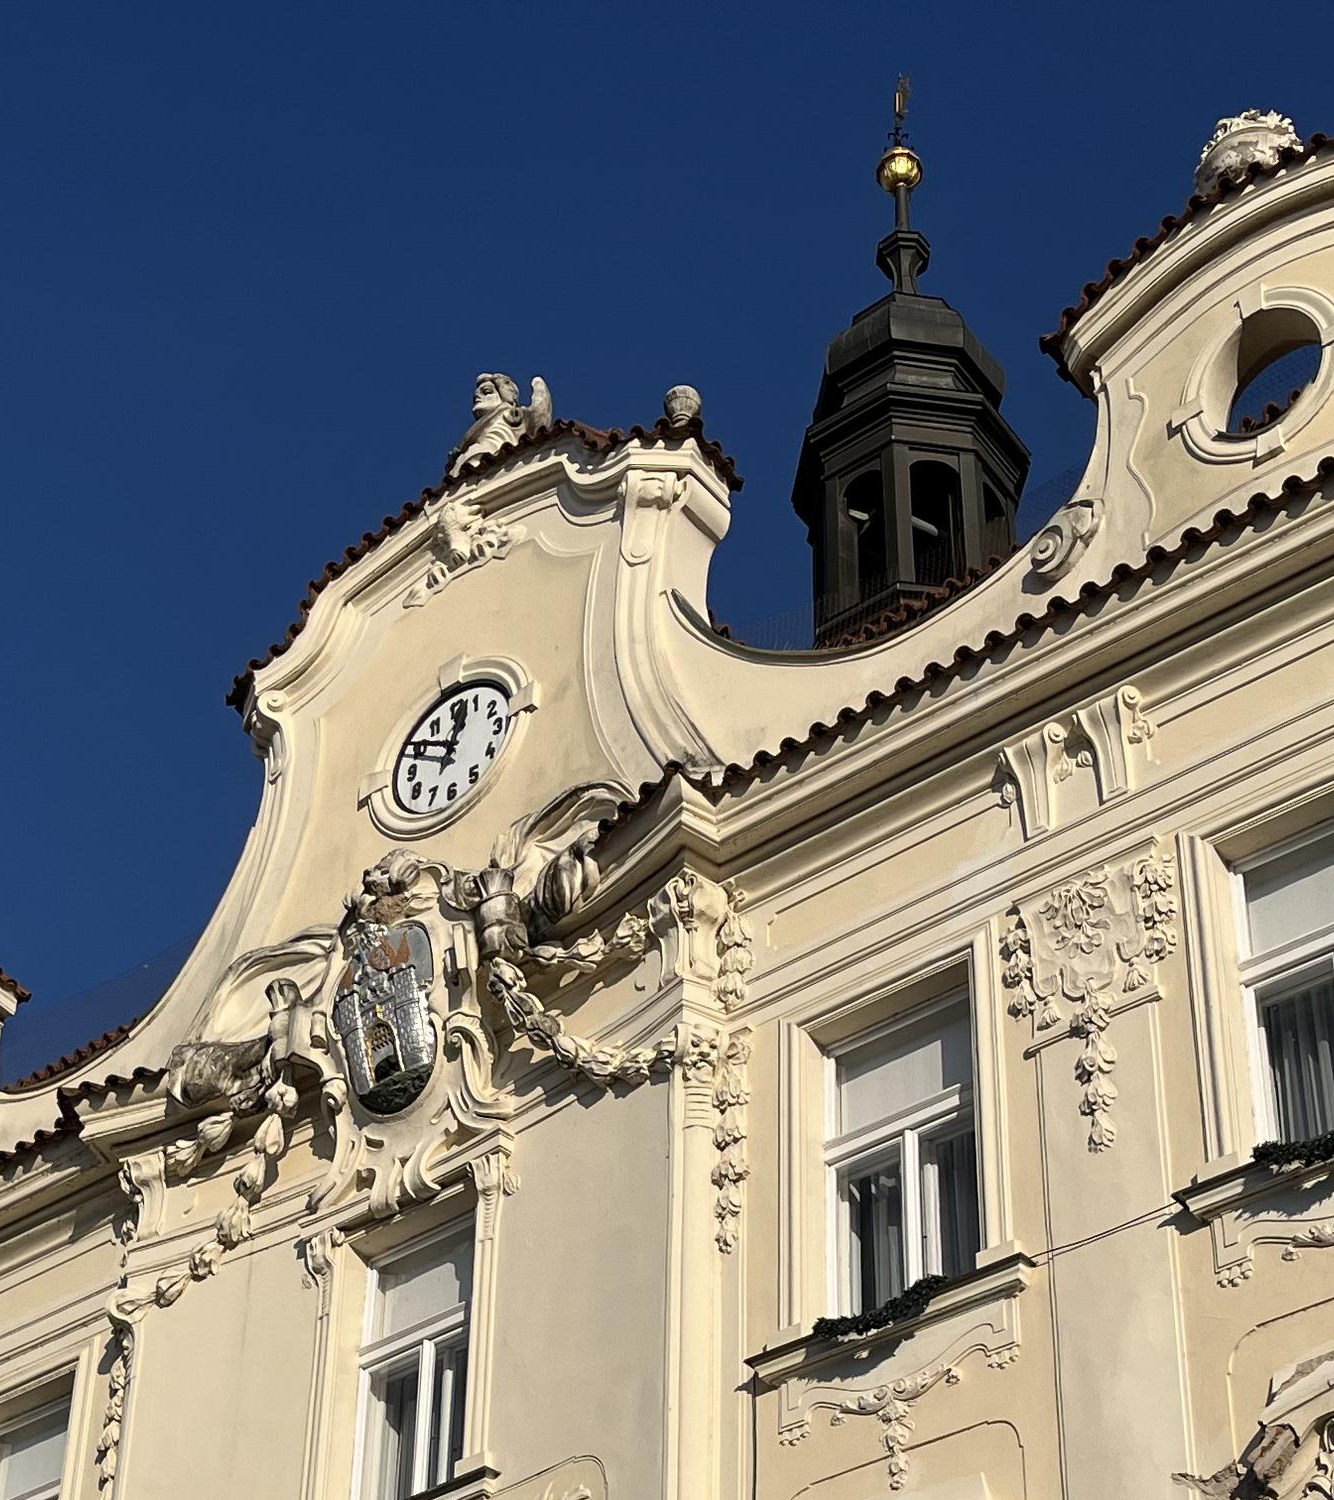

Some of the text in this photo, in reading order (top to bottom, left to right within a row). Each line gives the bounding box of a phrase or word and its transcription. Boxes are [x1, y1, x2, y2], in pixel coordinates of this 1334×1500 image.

[472, 694, 479, 712] 1
[487, 700, 498, 720] 2
[429, 716, 441, 737] 11
[492, 716, 503, 736] 3
[485, 741, 496, 760] 4
[407, 764, 418, 782] 9
[468, 764, 479, 784] 5
[412, 781, 422, 800] 8
[428, 785, 439, 807] 7
[447, 782, 458, 801] 6
